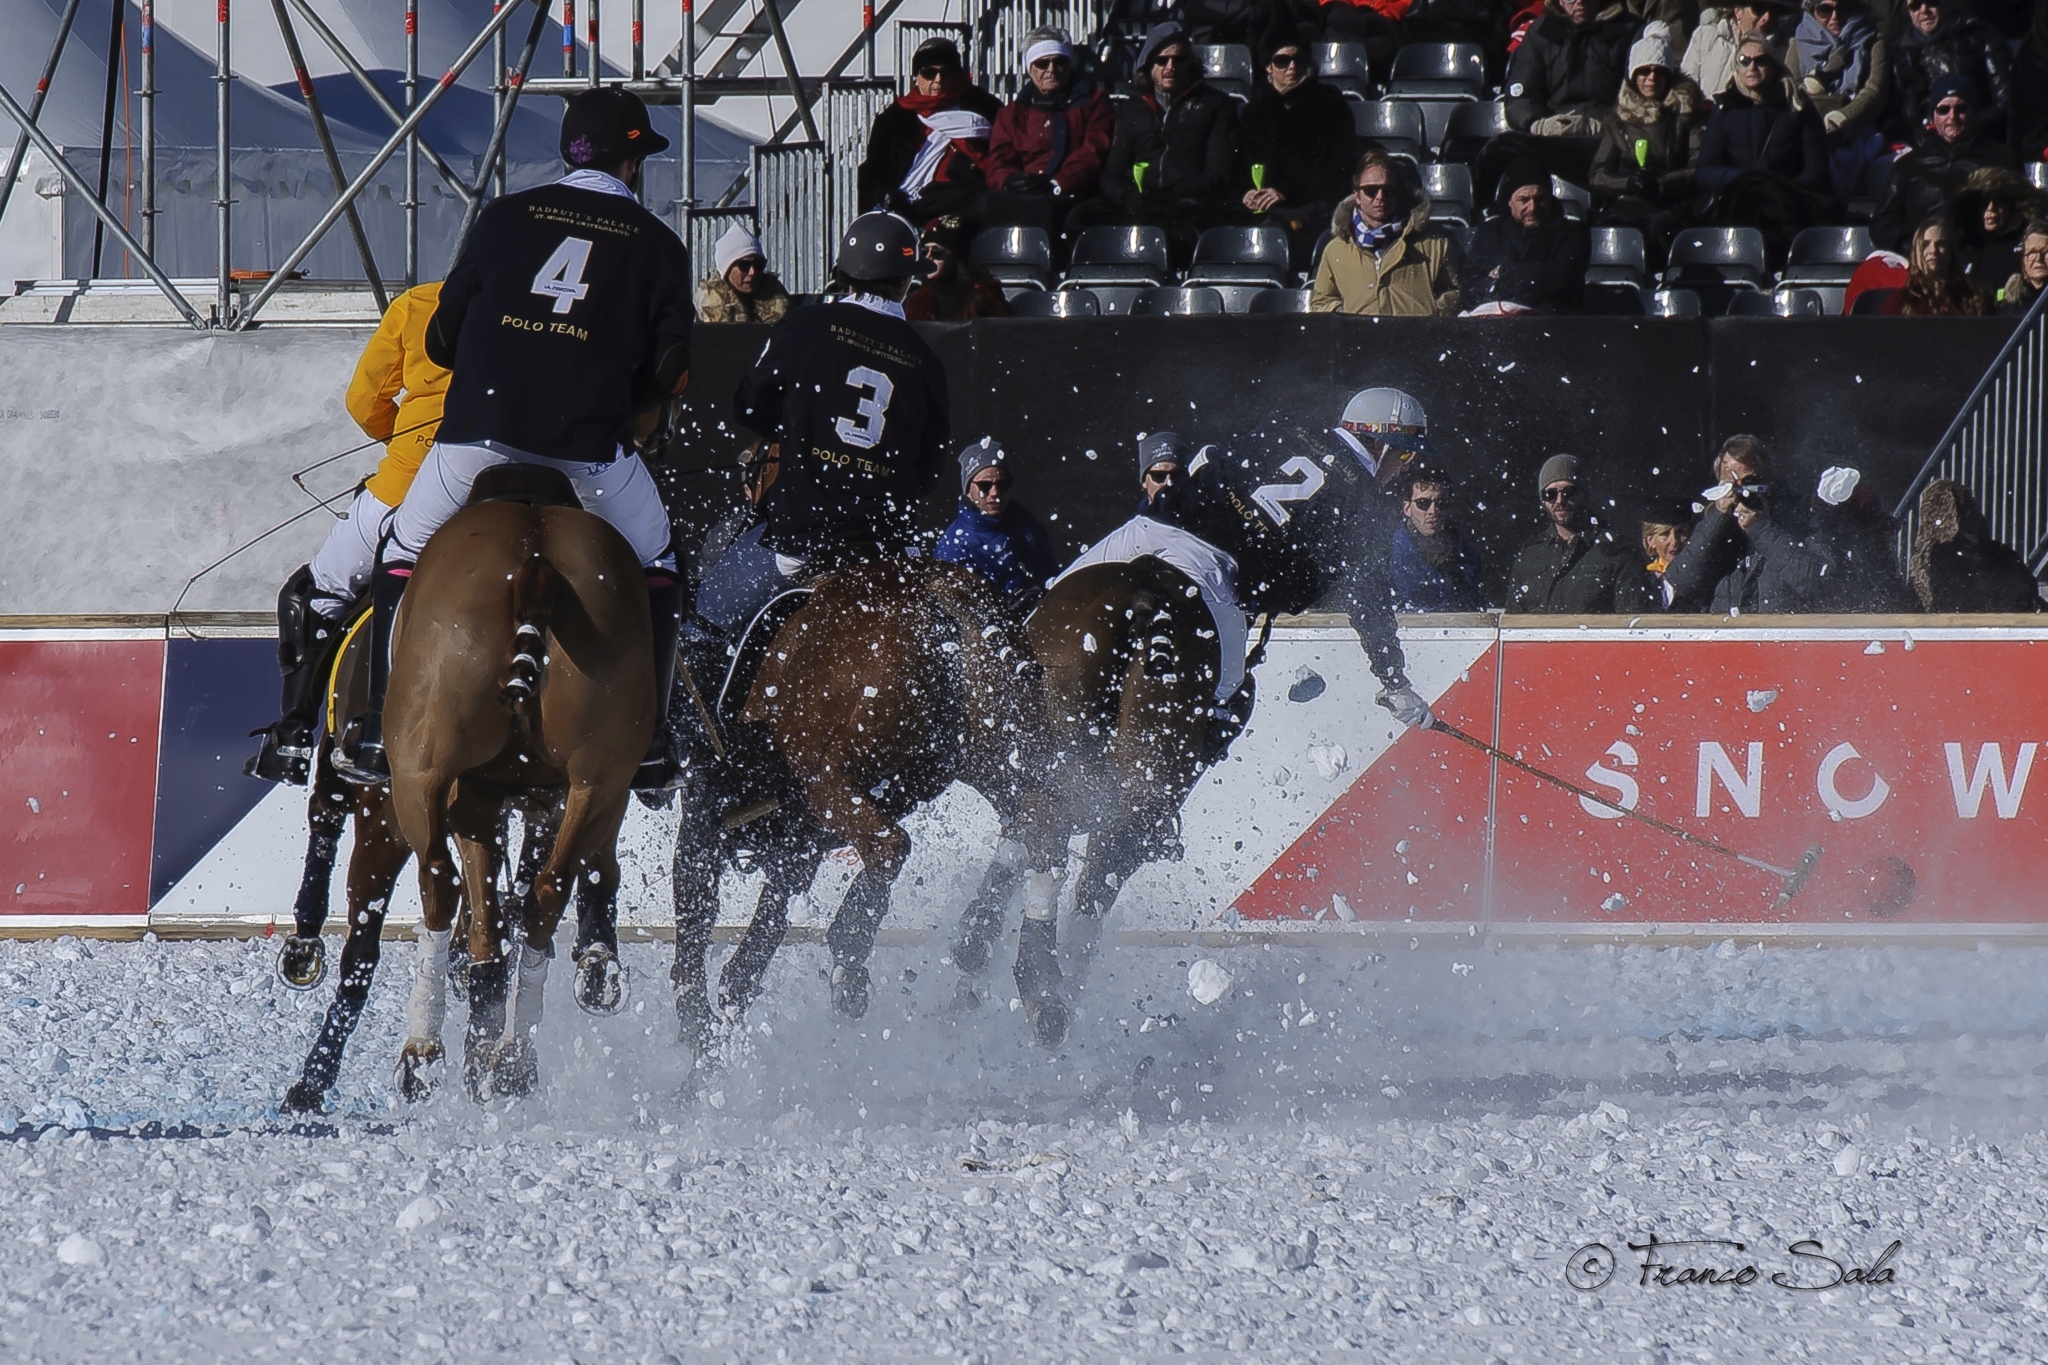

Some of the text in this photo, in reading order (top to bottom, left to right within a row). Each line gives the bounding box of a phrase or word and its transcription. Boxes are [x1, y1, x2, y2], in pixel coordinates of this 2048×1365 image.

[529, 205, 640, 234] BADRUTT'S PALACE
[530, 236, 593, 314] 4
[501, 315, 589, 341] POLO TEAM
[835, 365, 894, 449] 3
[812, 447, 890, 478] POLO TEAM
[1250, 456, 1325, 527] 2
[1579, 740, 2040, 820] SNOW
